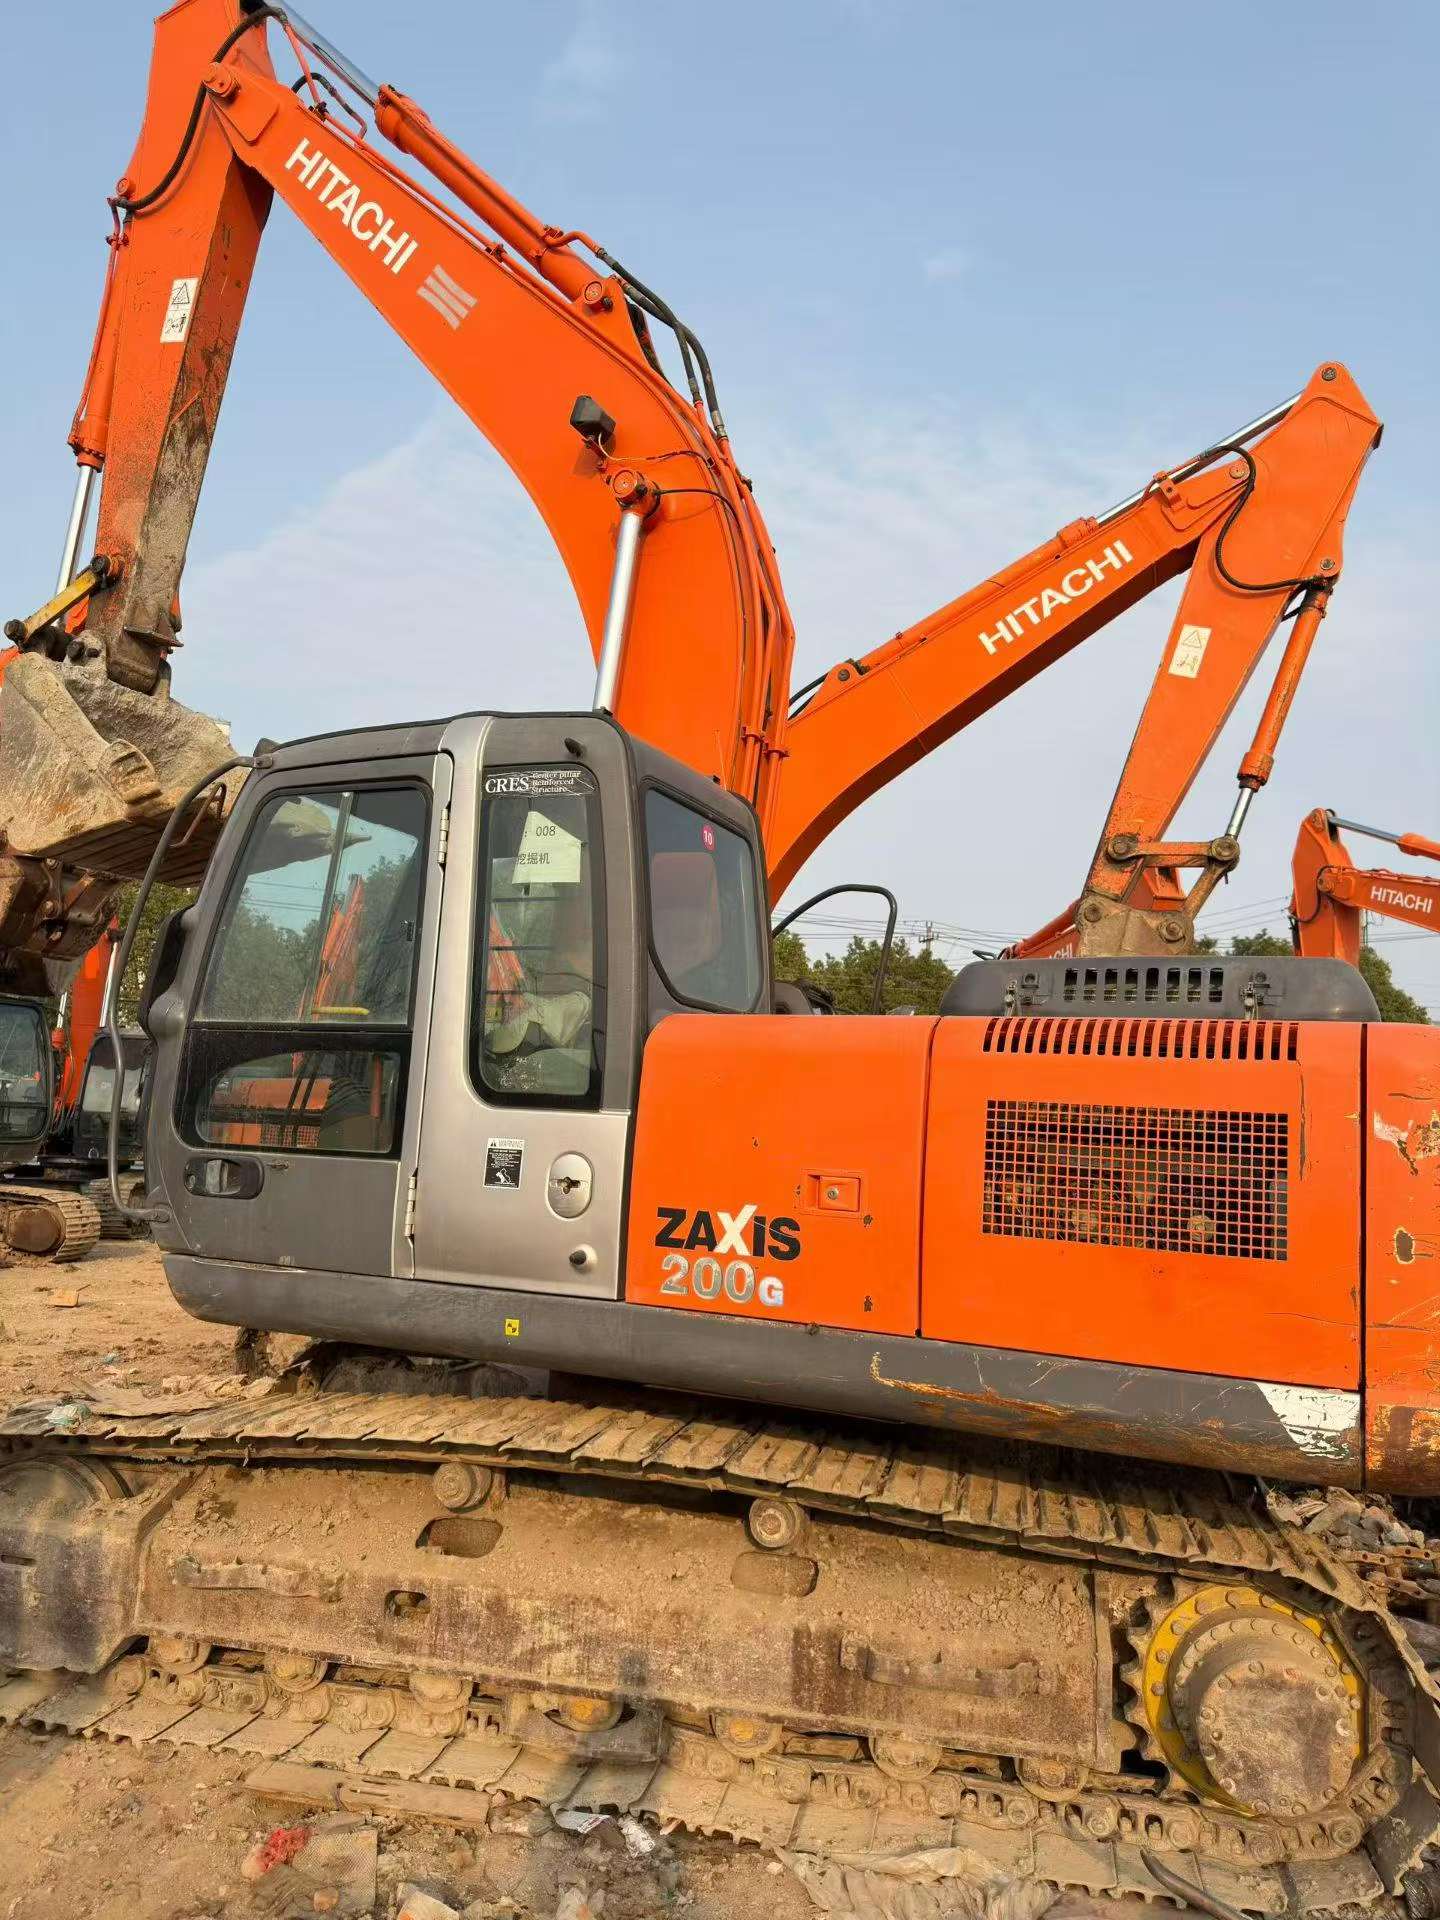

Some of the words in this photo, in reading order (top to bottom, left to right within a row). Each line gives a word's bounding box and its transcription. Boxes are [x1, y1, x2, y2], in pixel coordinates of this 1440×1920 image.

[284, 137, 418, 274] HITACHI
[978, 539, 1133, 656] HITACHI
[485, 776, 529, 793] CRES
[532, 778, 574, 787] Reinforced
[535, 825, 556, 837] 008
[1370, 886, 1433, 913] HITACHI
[655, 1204, 801, 1261] ZAXIS
